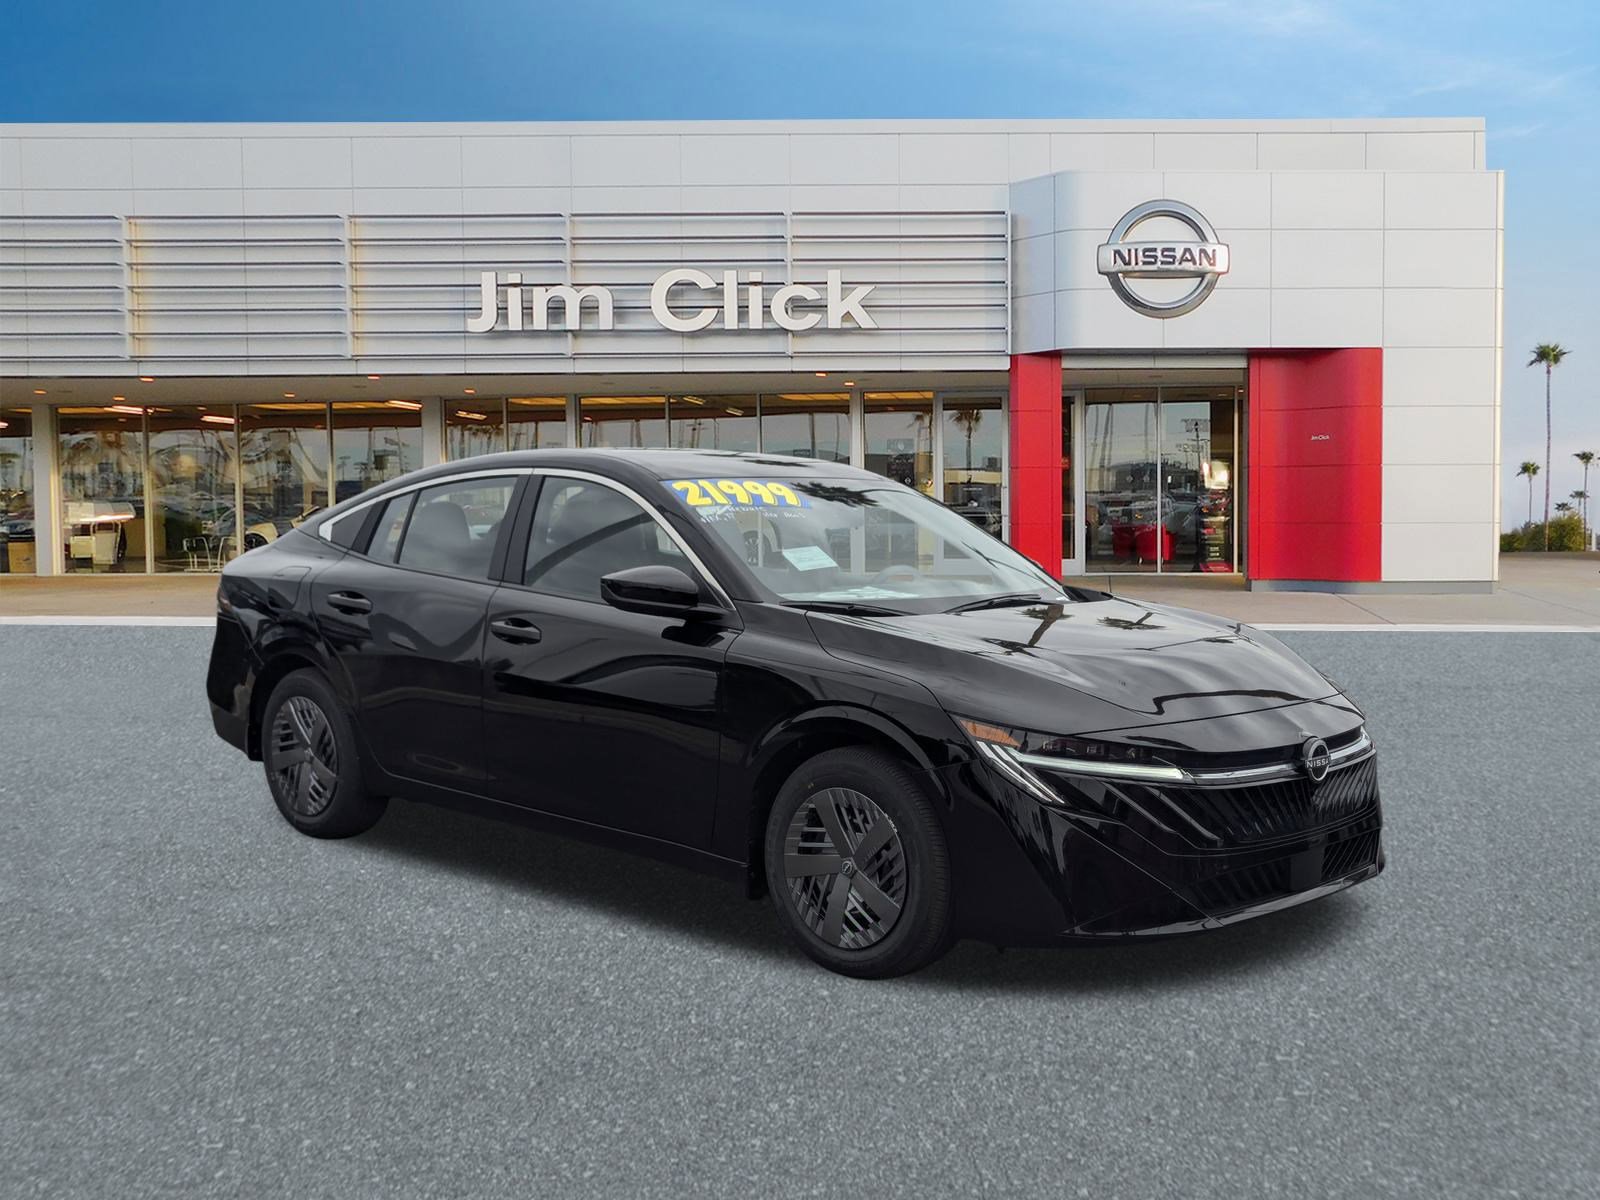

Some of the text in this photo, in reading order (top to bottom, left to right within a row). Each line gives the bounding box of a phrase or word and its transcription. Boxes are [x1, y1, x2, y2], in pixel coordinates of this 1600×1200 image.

[1112, 247, 1217, 267] NISSAN
[467, 268, 879, 333] Jim Click
[672, 480, 801, 506] 21999
